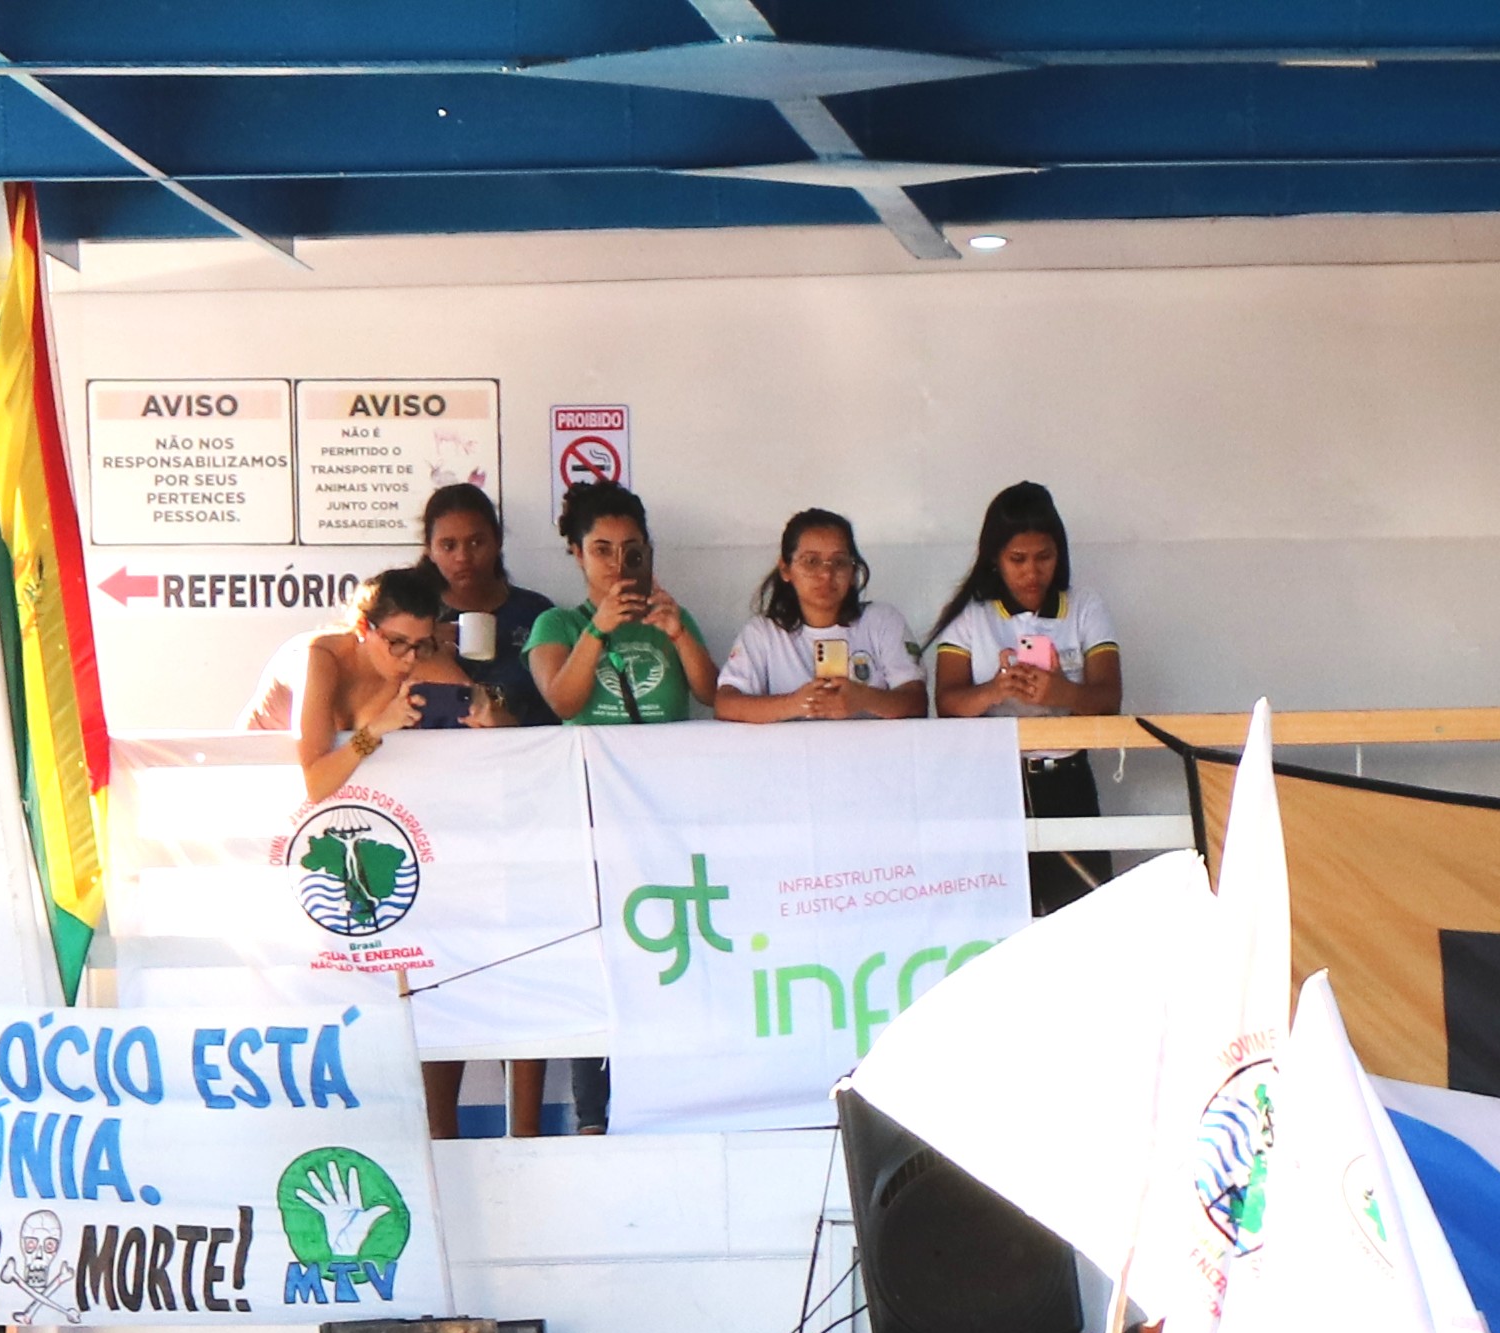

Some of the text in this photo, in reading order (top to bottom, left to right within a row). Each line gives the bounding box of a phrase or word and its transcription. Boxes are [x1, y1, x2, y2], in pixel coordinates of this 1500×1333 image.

[141, 394, 239, 417] AVISO
[349, 394, 446, 417] AVISO
[557, 412, 622, 428] PROIBIDO
[341, 426, 381, 438] NÃO É
[155, 435, 235, 450] NÃO NOS
[321, 447, 402, 456] PERMITIDO O
[102, 455, 288, 468] RESPONSABILIZAMOS
[311, 465, 413, 474] TRANSPORTE DE
[154, 474, 238, 486] POR SEUS
[315, 483, 409, 492] ANIMAIS VIVOS
[147, 492, 246, 504] PERTENCES
[327, 501, 398, 511] JUNTO COM
[153, 510, 241, 523] PESSOAIS.
[318, 519, 407, 528] PASSAGEIROS.
[163, 565, 358, 608] REFEITÓRIO
[371, 790, 396, 811] POR
[392, 803, 435, 864] BARRAGENS
[778, 864, 916, 895] INFRAESTRUTURA
[780, 873, 1008, 917] E JUSTIÇA SOCIOAMBIENTAL
[623, 853, 733, 985] gt
[349, 939, 382, 951] Brasil
[352, 952, 361, 963] E
[365, 946, 424, 962] ENERGIA
[193, 1005, 362, 1110] ESTÁ
[76, 1205, 254, 1312] MORTE!
[284, 1261, 397, 1304] MTV
